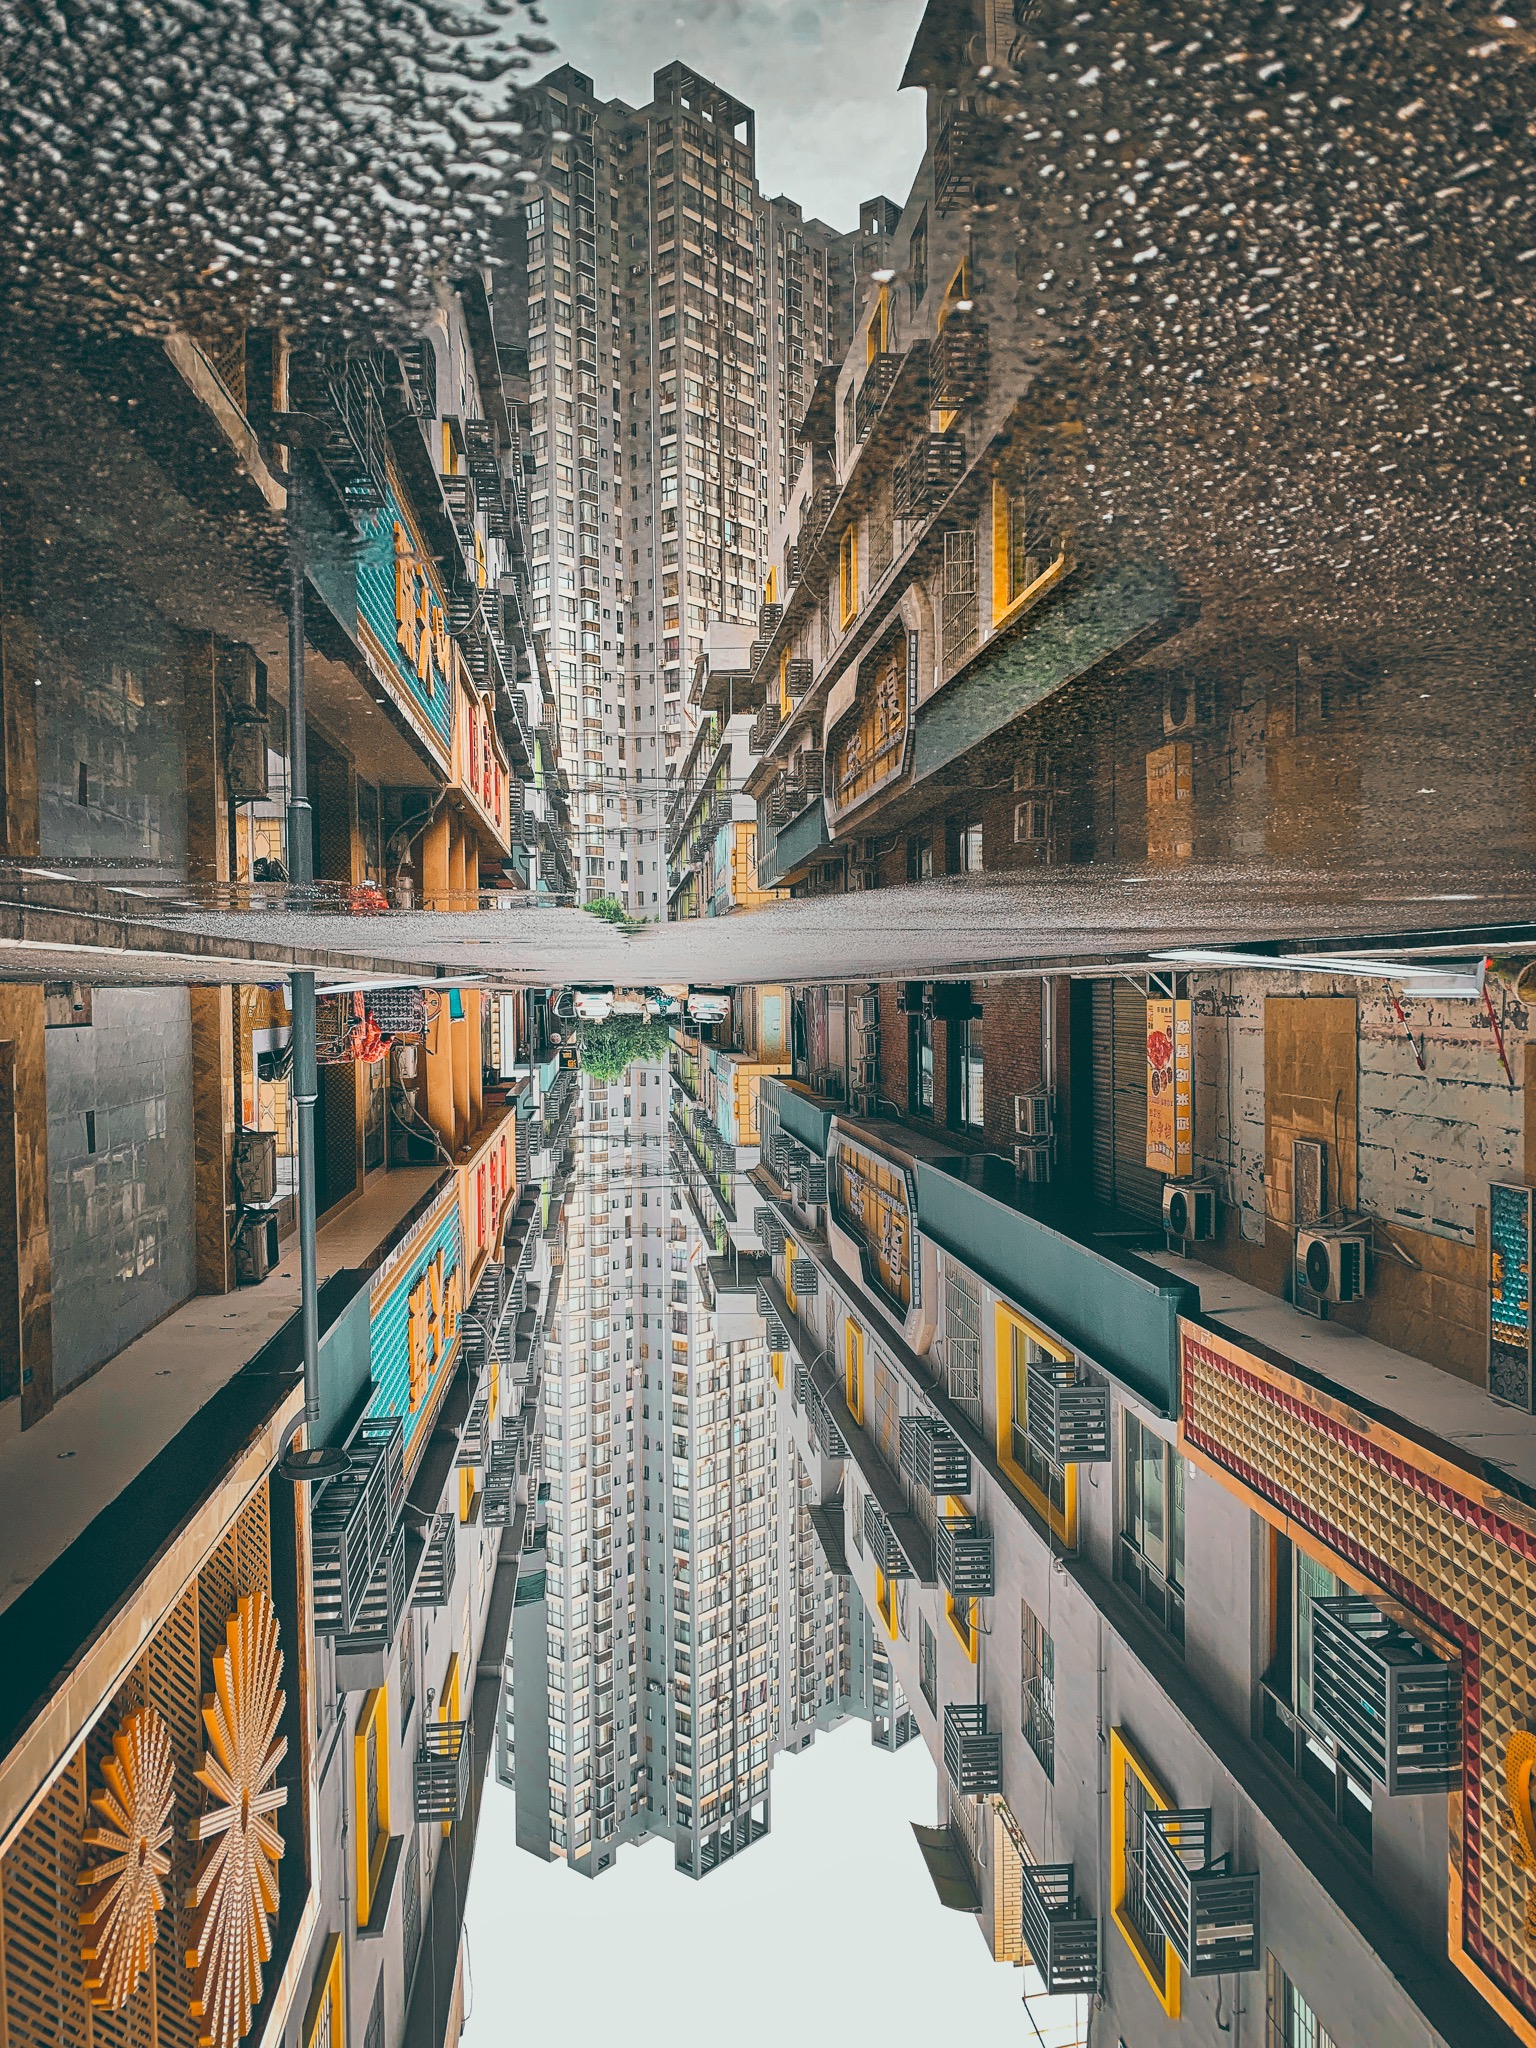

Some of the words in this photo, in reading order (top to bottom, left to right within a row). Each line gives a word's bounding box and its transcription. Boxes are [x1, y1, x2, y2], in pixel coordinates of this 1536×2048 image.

[1176, 1020, 1189, 1154] 欢迎来吃宵夜
